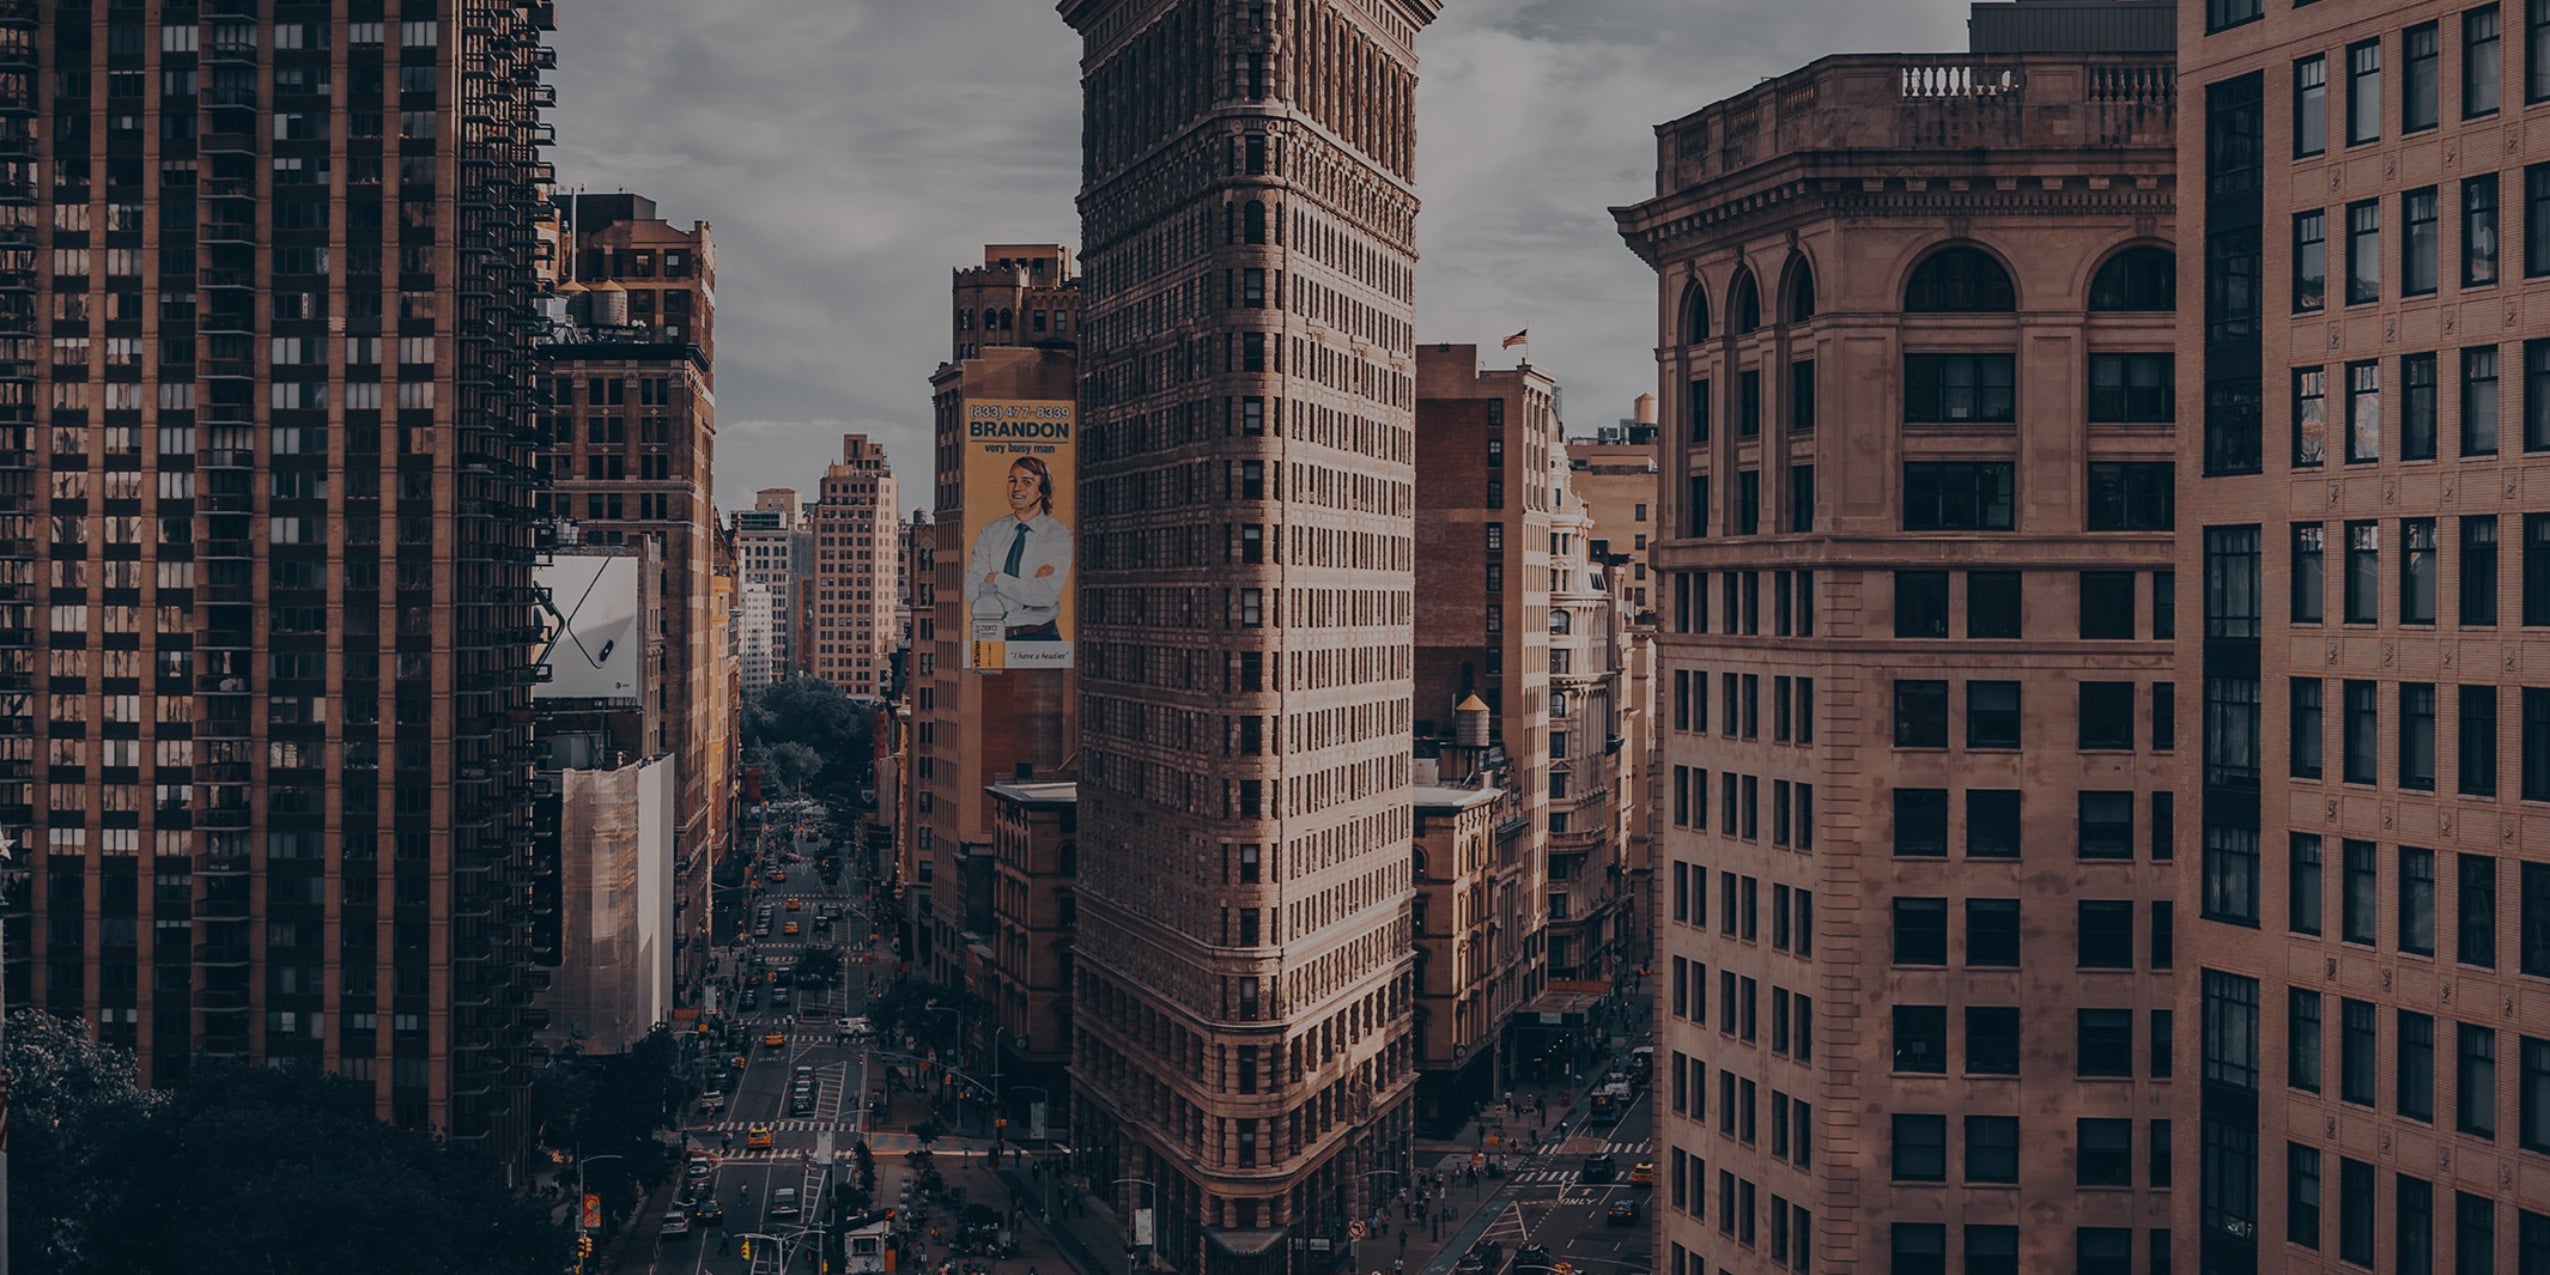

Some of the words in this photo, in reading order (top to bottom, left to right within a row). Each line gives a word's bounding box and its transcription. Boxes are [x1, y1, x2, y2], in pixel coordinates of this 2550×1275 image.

[970, 406, 1002, 420] (833)
[1005, 407, 1070, 419] 477-8339
[970, 421, 1069, 438] BRANDON
[985, 445, 1005, 454] very
[1008, 443, 1031, 455] busy
[1034, 445, 1055, 453] man
[1559, 1198, 1598, 1206] ONLY
